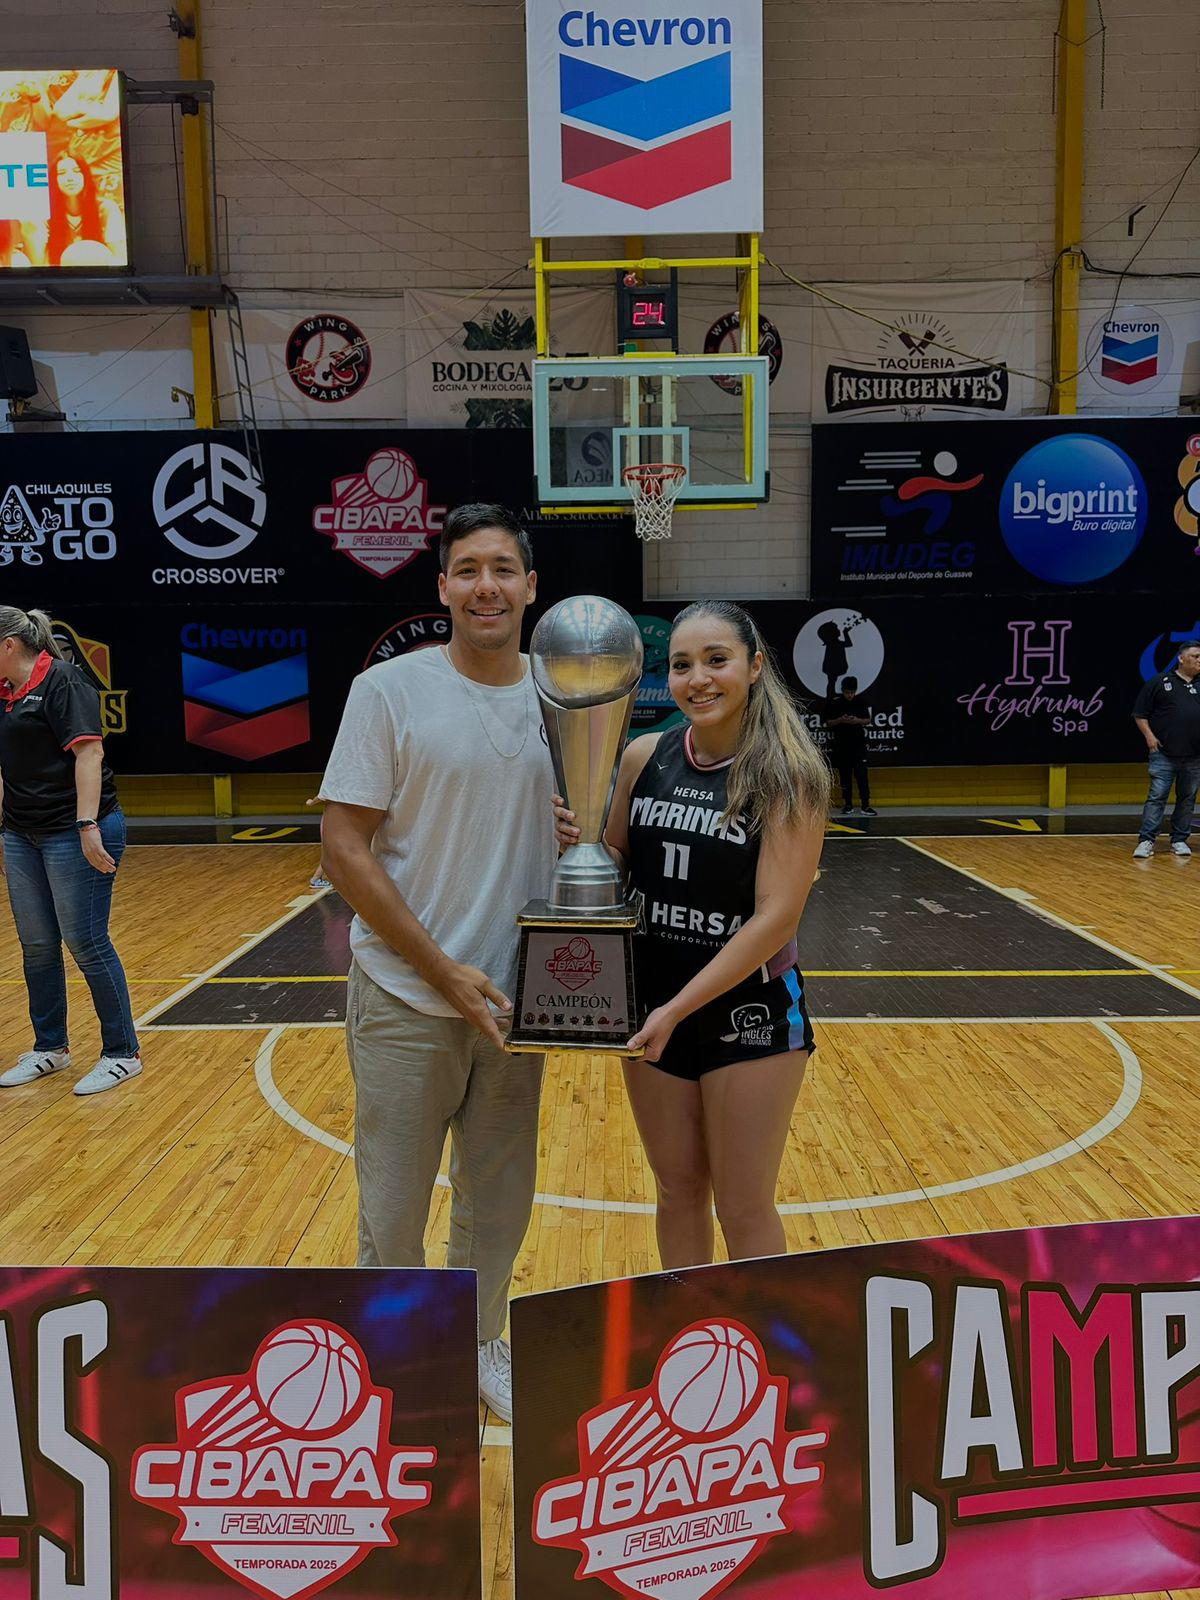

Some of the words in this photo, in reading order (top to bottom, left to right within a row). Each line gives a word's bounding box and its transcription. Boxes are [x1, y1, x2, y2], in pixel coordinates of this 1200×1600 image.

[558, 10, 731, 47] Chevron
[632, 302, 665, 325] 24
[711, 312, 770, 337] WINS
[1102, 320, 1160, 334] Chevron
[432, 361, 532, 382] BODEGA
[877, 357, 956, 371] TAQUERIA
[309, 385, 350, 400] PARK
[432, 383, 468, 392] COCINA
[472, 383, 478, 391] Y
[832, 369, 1004, 407] INSURGENTES
[25, 483, 112, 495] CHILAQUILES
[53, 496, 115, 528] TO
[1013, 479, 1138, 524] bigprint
[314, 507, 447, 530] CIBAPAC
[1071, 518, 1099, 532] Buro
[1101, 517, 1137, 533] digital
[52, 528, 117, 560] GO
[352, 535, 413, 546] FEMENIL
[840, 540, 977, 570] IMUDEG
[866, 572, 897, 582] Municipal
[908, 571, 933, 581] Deporte
[180, 622, 308, 650] Chevron
[1004, 620, 1073, 686] H
[957, 682, 1105, 732] Hydrumb
[1051, 716, 1089, 737] Spa
[673, 785, 715, 802] HERSA
[629, 796, 748, 846] MARINAS
[661, 840, 692, 881] 11
[651, 900, 744, 937] HERSA
[545, 960, 603, 972] CIBAPAC
[535, 993, 612, 1009] CAMPEÓN
[134, 1446, 436, 1501] CIBAPAC
[536, 1431, 828, 1540] CIBAPAC
[220, 1512, 355, 1536] FEMENIL
[623, 1509, 753, 1557] FEMENIL
[233, 1558, 308, 1570] TEMPORADA
[309, 1558, 338, 1570] 2025
[635, 1565, 709, 1590] TEMPORADA
[709, 1558, 737, 1574] 2025
